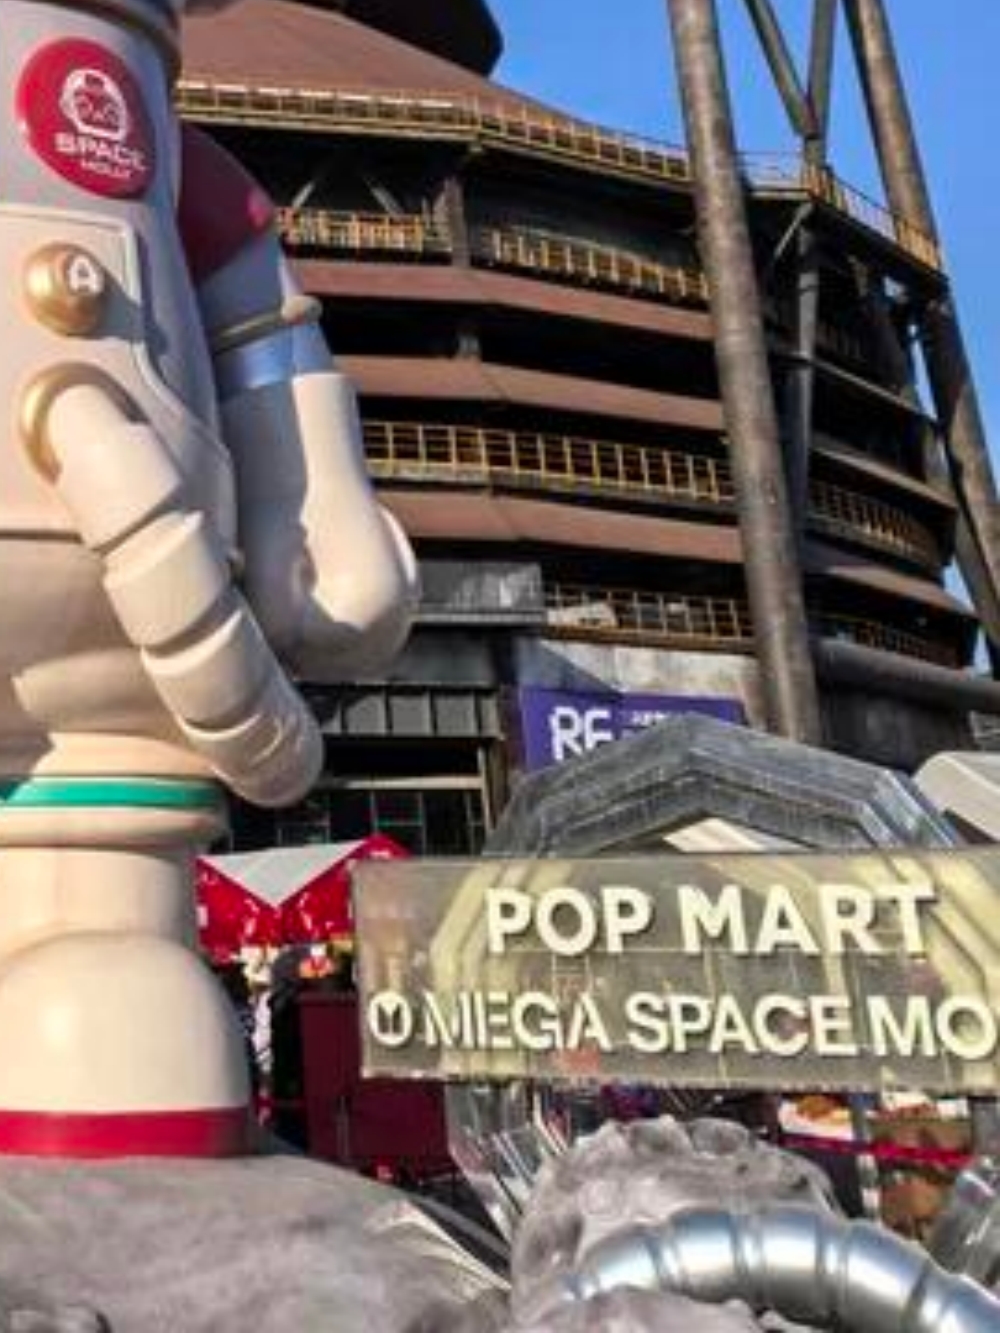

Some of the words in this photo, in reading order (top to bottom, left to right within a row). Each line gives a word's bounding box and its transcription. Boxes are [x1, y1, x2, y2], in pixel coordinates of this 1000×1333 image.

[484, 886, 655, 955] POP
[678, 884, 939, 956] MART
[625, 991, 858, 1055] SPACE
